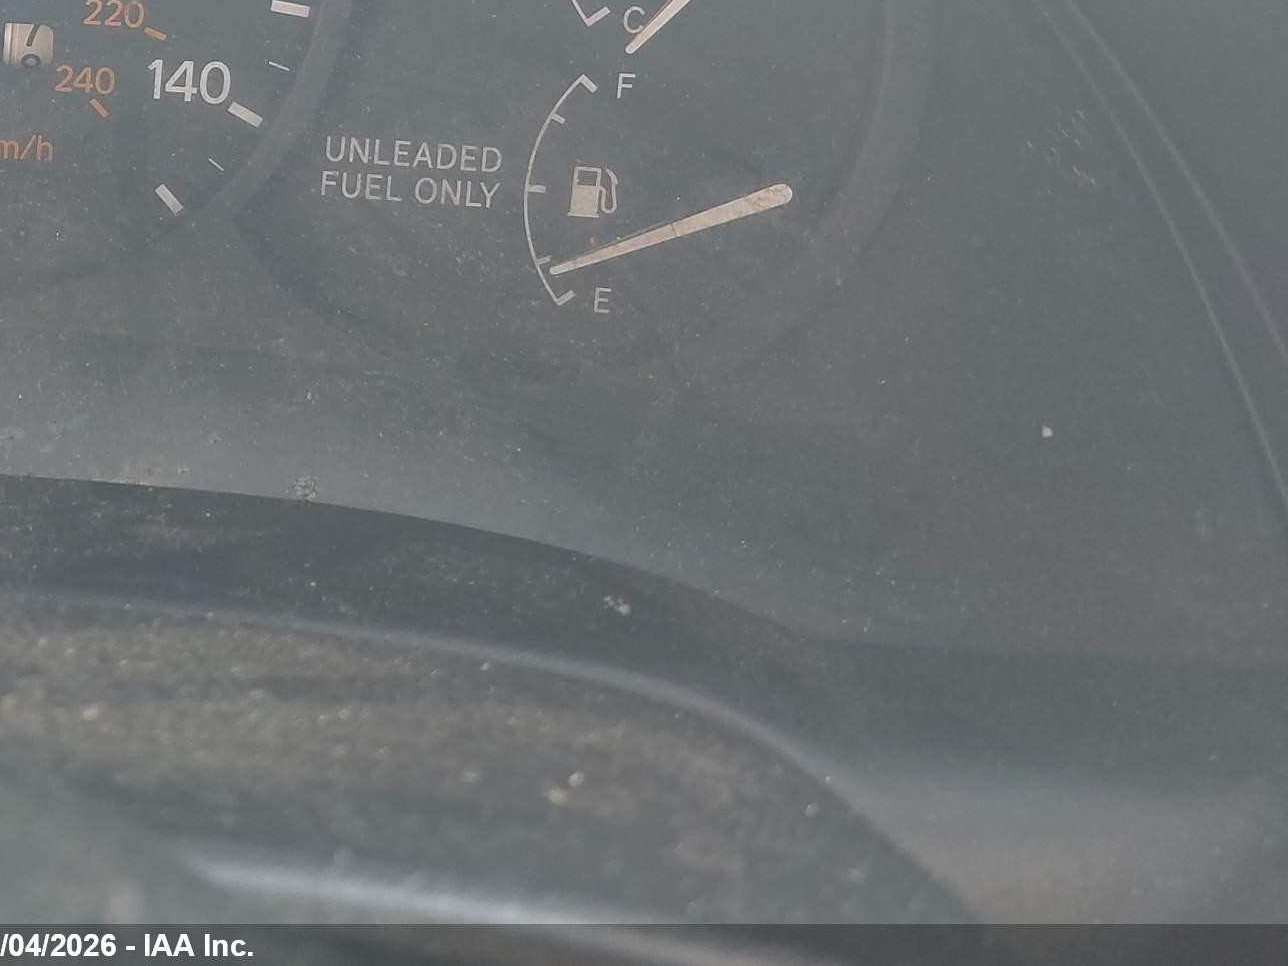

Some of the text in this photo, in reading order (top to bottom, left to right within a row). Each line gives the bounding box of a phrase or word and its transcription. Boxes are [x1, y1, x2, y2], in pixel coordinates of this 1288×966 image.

[623, 7, 644, 34] C
[55, 65, 115, 95] 240
[147, 59, 231, 104] 140
[617, 74, 636, 98] F
[325, 136, 502, 173] UNLEADED
[321, 171, 500, 209] FUEL ONLY
[594, 288, 612, 313] E
